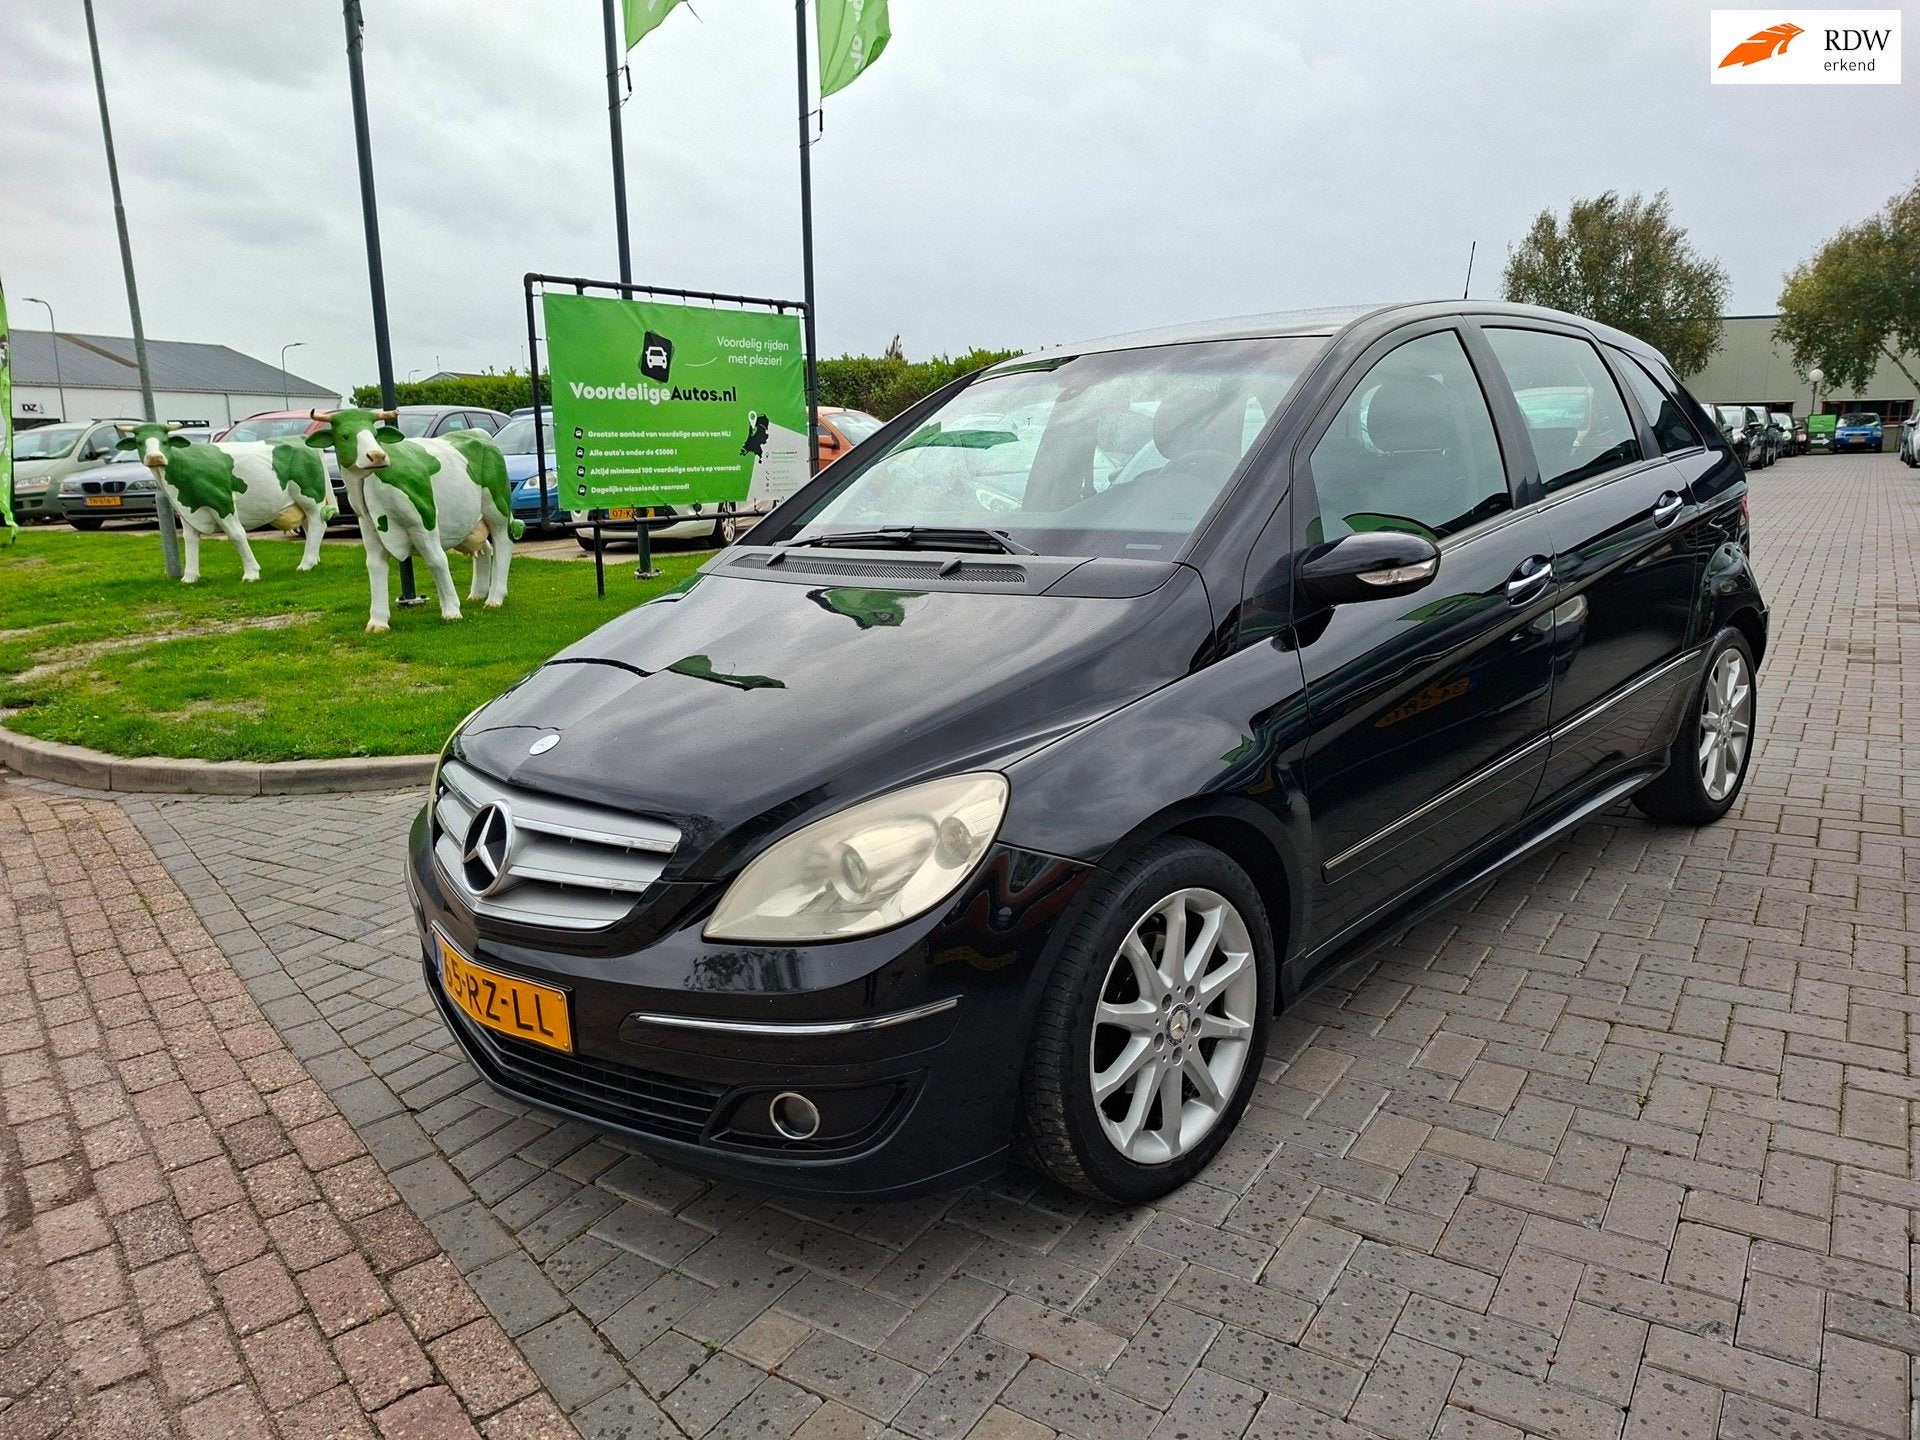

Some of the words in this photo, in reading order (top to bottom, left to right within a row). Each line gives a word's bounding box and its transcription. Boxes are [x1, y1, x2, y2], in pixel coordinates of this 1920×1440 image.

[717, 335, 762, 352] Voordelig
[764, 339, 789, 353] rijden
[728, 354, 748, 364] met
[749, 354, 782, 367] plezier!
[569, 382, 737, 406] VoordeligeAutos.nl
[588, 430, 619, 438] Grootste
[620, 430, 645, 438] aanbod
[658, 430, 690, 439] voordelige
[691, 430, 710, 438] auto's
[589, 449, 603, 457] Alle
[604, 448, 625, 456] auto's
[625, 448, 645, 456] onder
[645, 448, 654, 456] de
[655, 448, 674, 456] €5000
[590, 467, 609, 476] Altijd
[610, 466, 641, 475] minimaal
[641, 466, 653, 474] 100
[653, 465, 686, 474] voordelige
[686, 465, 705, 473] auto's
[714, 464, 741, 472] voorraad!
[591, 486, 623, 495] Dagelijks
[624, 484, 660, 493] wisselende
[660, 483, 690, 491] voorraad!
[444, 950, 554, 1038] 65-RZ-LL
